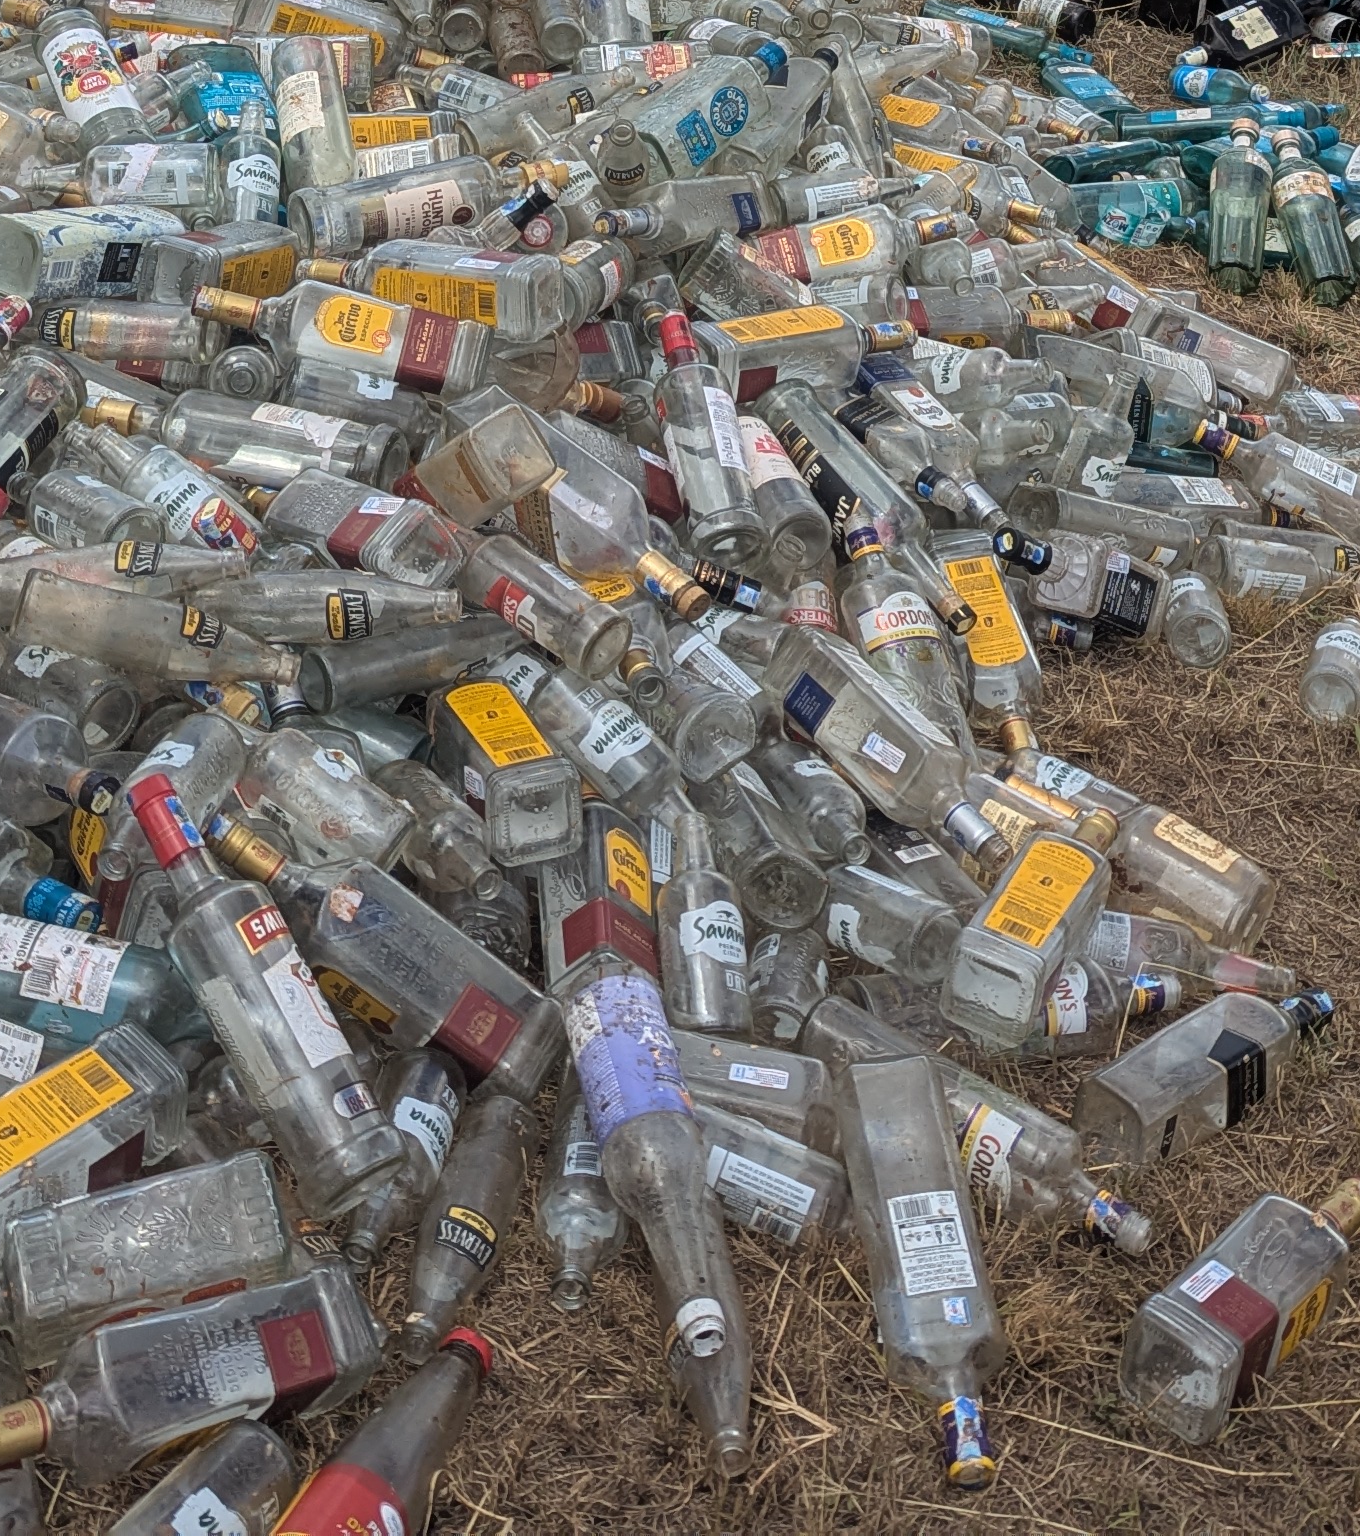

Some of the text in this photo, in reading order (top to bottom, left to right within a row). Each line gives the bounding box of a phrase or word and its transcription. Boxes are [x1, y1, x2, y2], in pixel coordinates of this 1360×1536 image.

[711, 89, 745, 133] OLMECA TEQUILA
[836, 225, 854, 258] Cuervo
[341, 302, 361, 344] Cuervo
[344, 592, 367, 640] EVERVESS
[612, 848, 646, 883] Cuervo
[438, 1218, 493, 1267] EVERVESS
